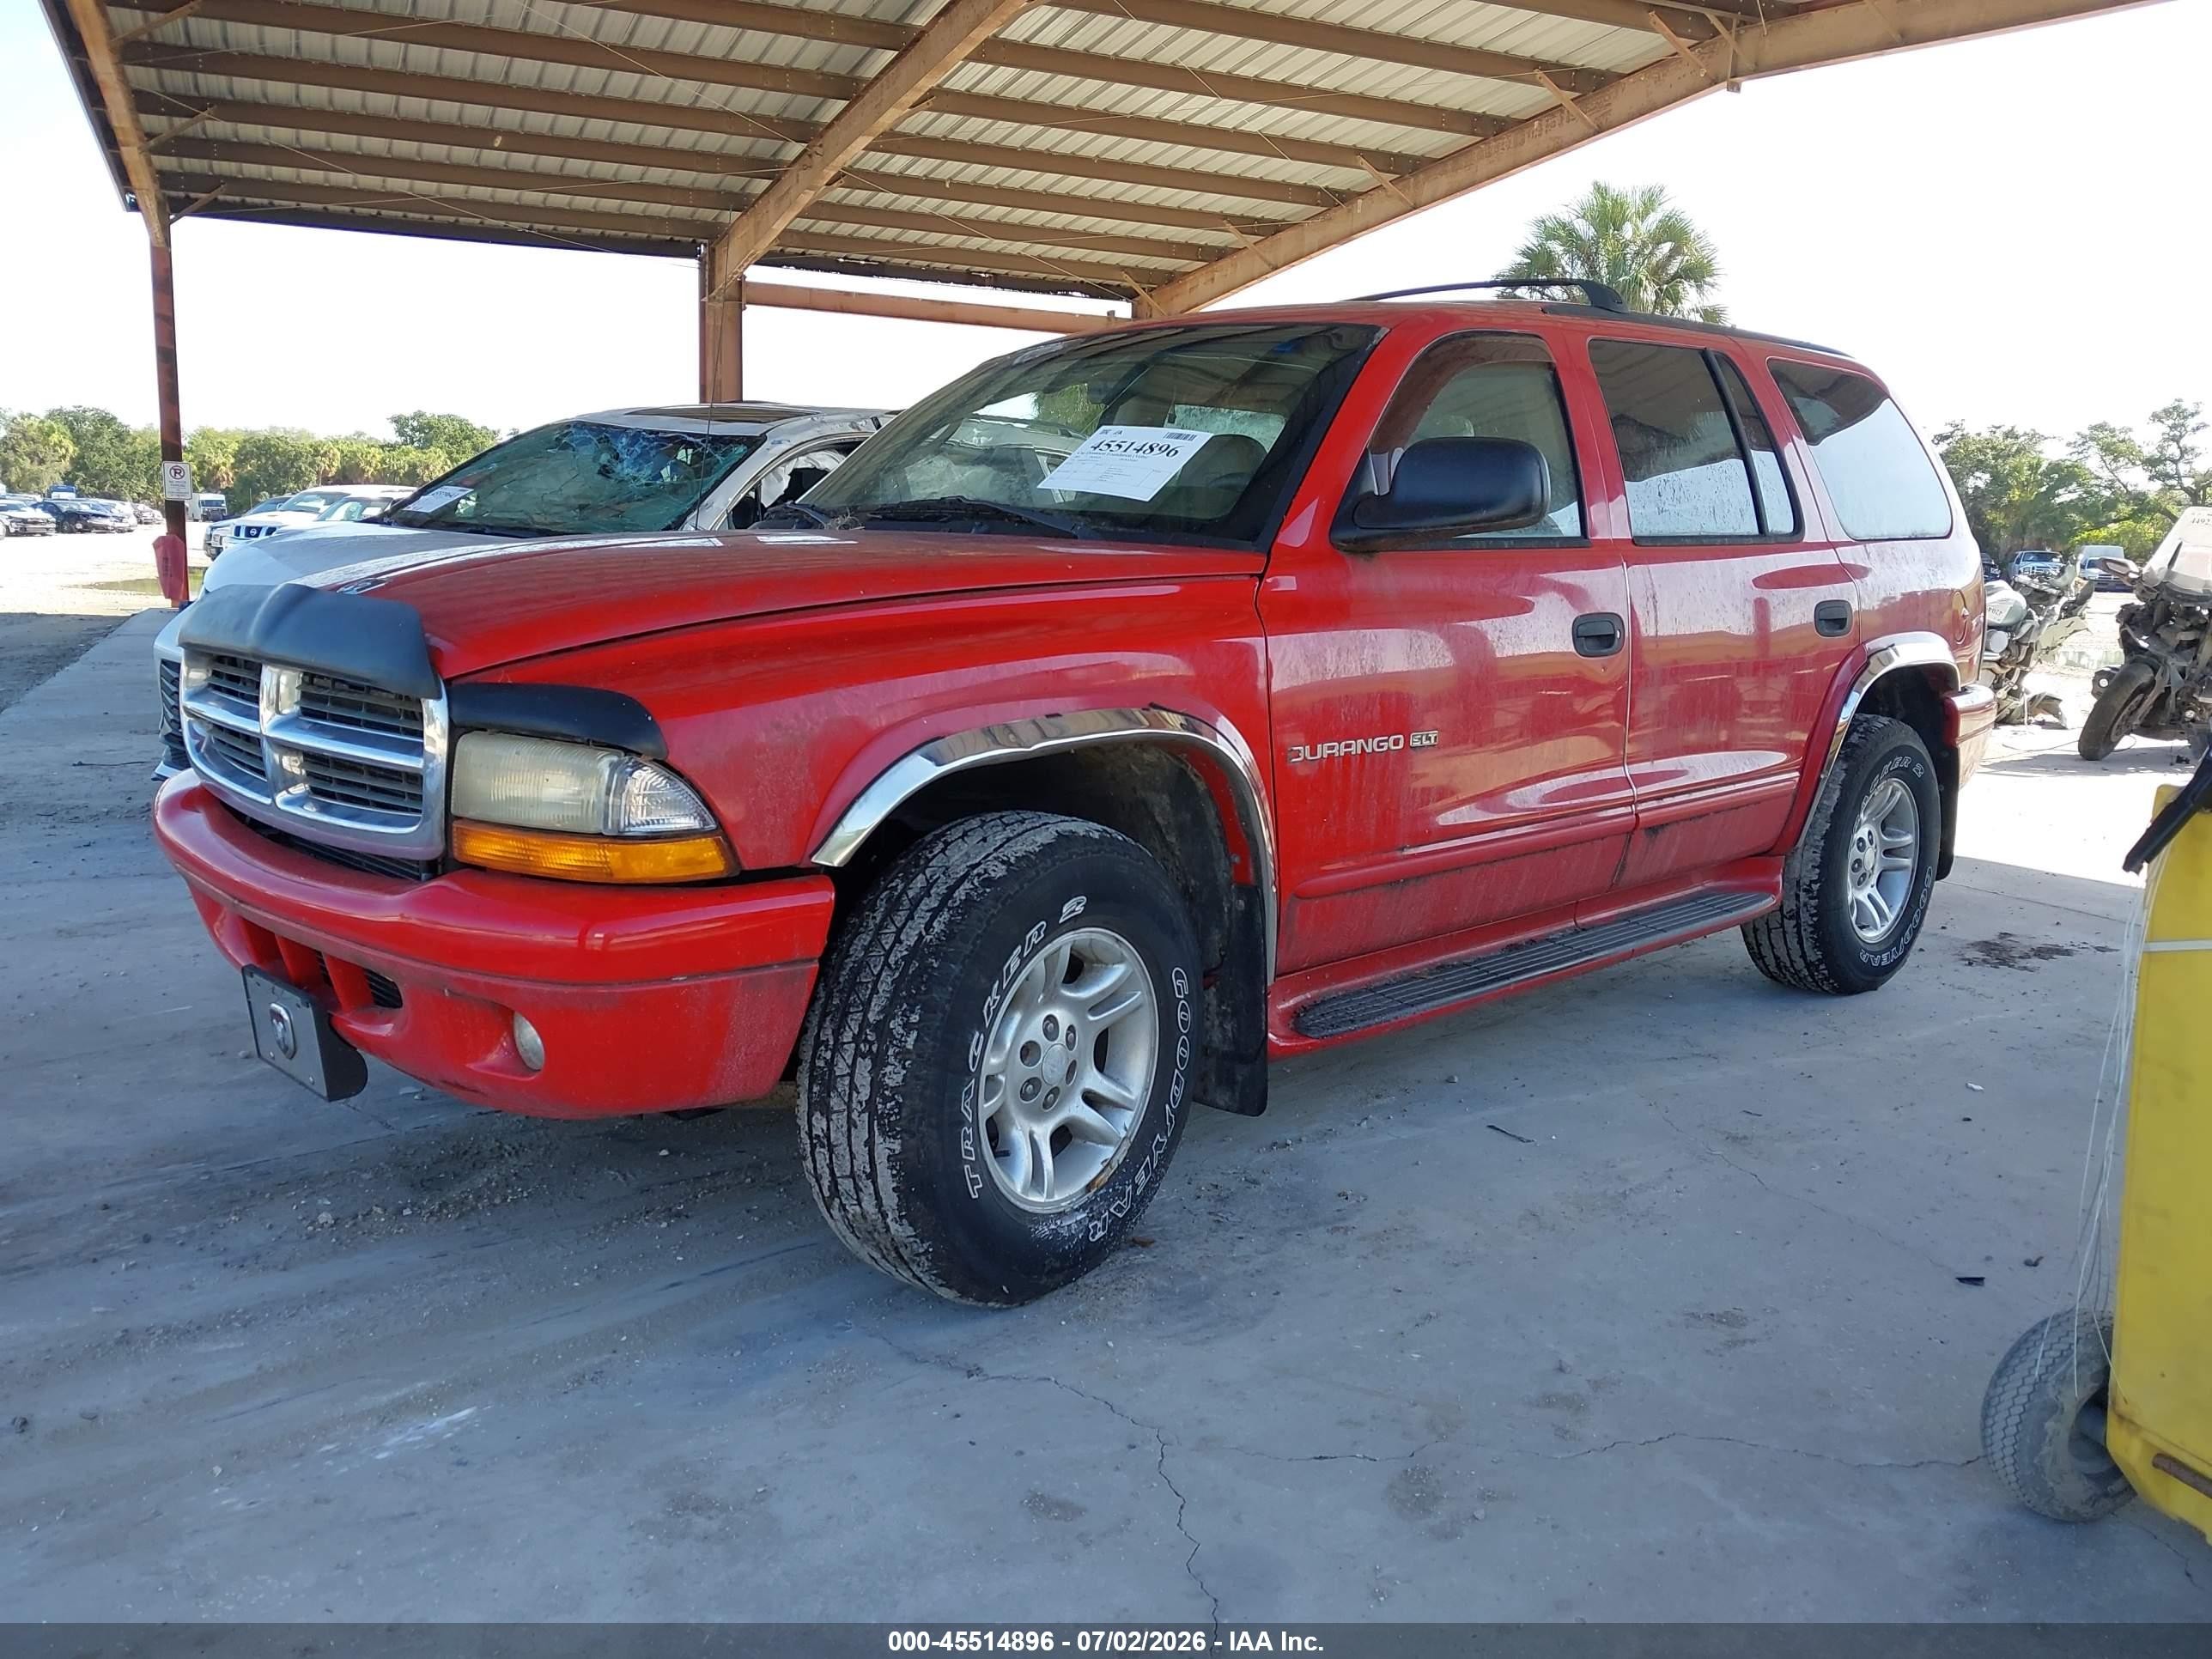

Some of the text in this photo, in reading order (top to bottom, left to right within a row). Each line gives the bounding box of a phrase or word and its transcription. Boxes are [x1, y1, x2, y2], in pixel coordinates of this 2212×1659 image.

[1090, 439, 1185, 458] 45514896
[1289, 731, 1438, 763] DURANGO SLT
[1859, 866, 1933, 966] GOODYEAR
[960, 895, 1087, 1200] TRACKER 2
[1088, 966, 1191, 1243] GOODYEAR
